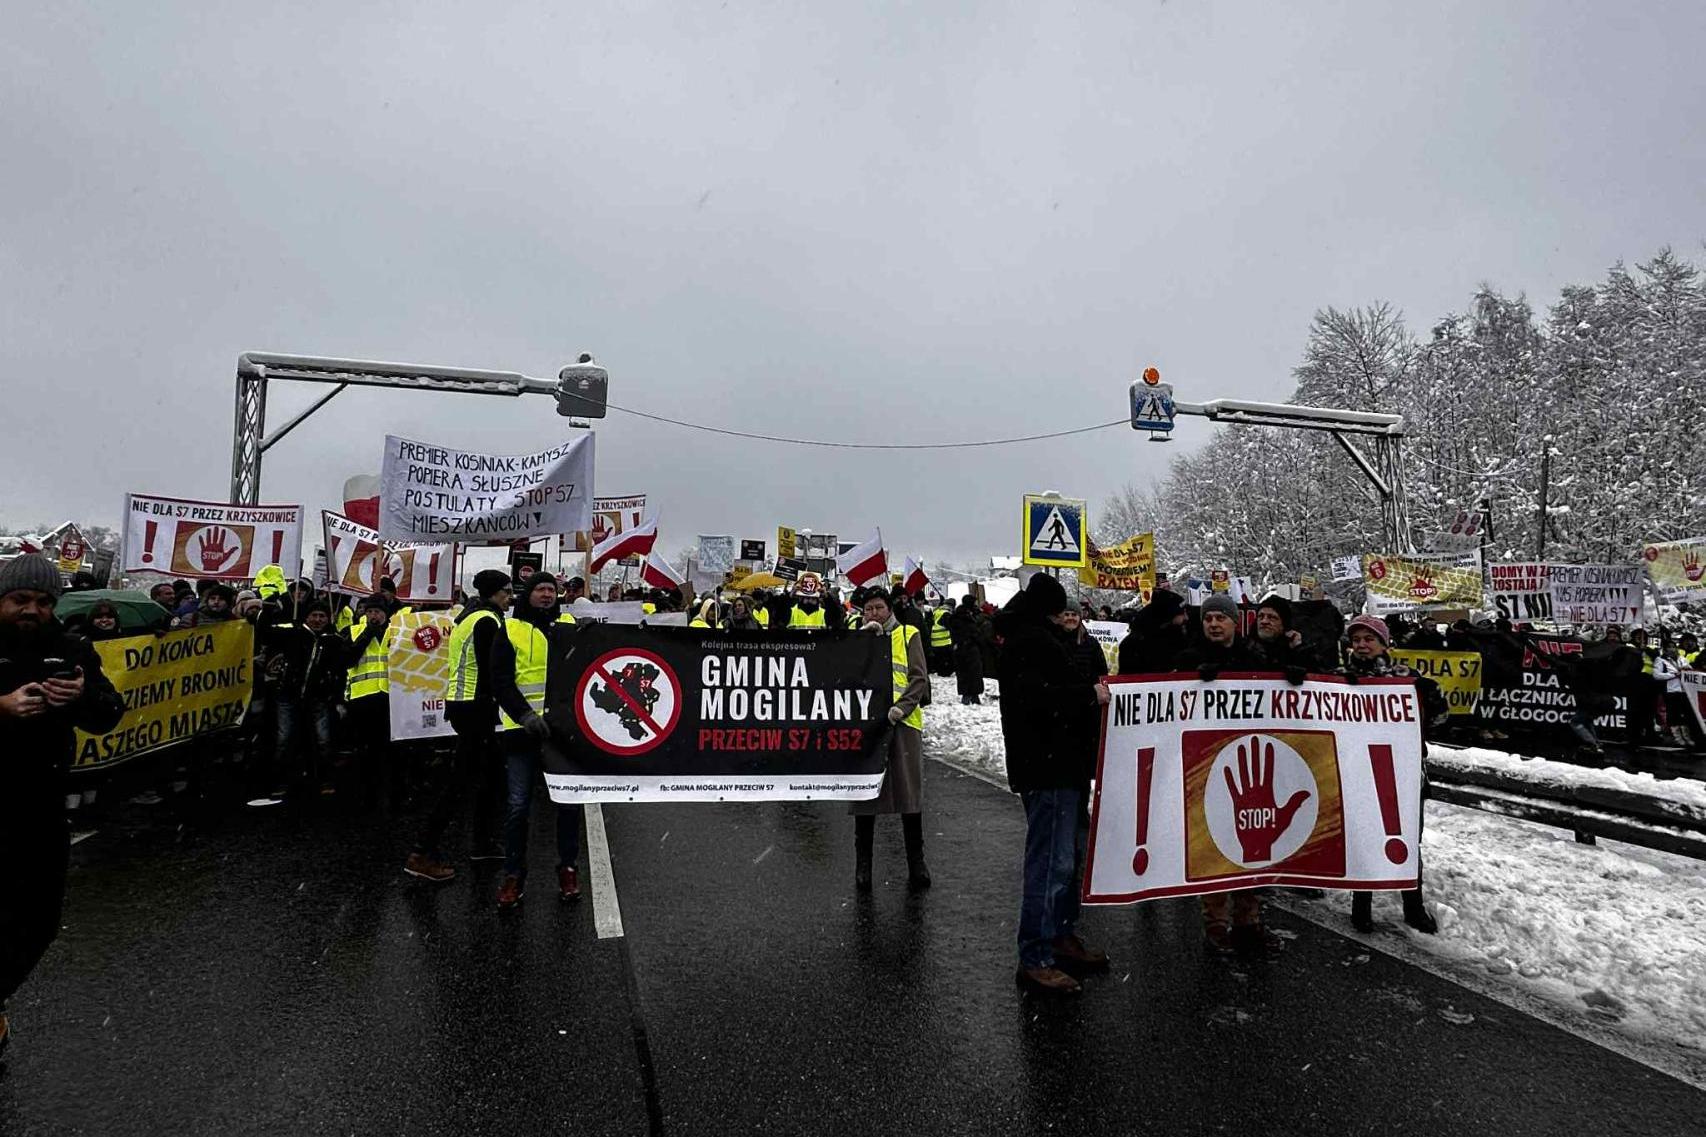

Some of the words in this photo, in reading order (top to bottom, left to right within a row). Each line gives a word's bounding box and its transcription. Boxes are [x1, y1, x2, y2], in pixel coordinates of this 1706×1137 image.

[400, 441, 450, 468] PREMIER
[455, 442, 570, 473] KOSINIAK-KAMYSZ
[408, 464, 464, 490] POPIERA
[470, 468, 544, 492] SŁUSZNE
[405, 489, 498, 512] POSTULATY
[514, 486, 552, 508] STOP
[555, 484, 575, 502] S7
[132, 500, 148, 514] NIE
[152, 503, 172, 516] DLA
[176, 506, 188, 518] S7
[192, 507, 224, 521] PRZEZ
[226, 510, 296, 523] KRZYSZKOWICE
[340, 521, 356, 534] DLA
[358, 528, 370, 538] S7
[202, 551, 224, 560] STOP!
[1492, 565, 1522, 578] DOMY
[1526, 565, 1538, 578] W
[1496, 594, 1520, 620] S7
[1588, 607, 1608, 622] DLA
[418, 628, 432, 638] NIE
[125, 646, 154, 672] DO
[158, 632, 215, 664] KOŃCA
[424, 639, 435, 649] S7
[701, 640, 734, 650] Kolejna
[736, 642, 758, 650] trasa
[760, 642, 816, 651] ekspresowa?
[701, 654, 810, 688] GMINA
[1416, 658, 1452, 677] DLA
[1460, 660, 1480, 677] S7
[124, 678, 176, 712] ZIEMY
[181, 659, 246, 697] BRONIĆ
[1522, 672, 1560, 689] DLA
[1684, 673, 1698, 684] NIE
[422, 700, 444, 712] NIE
[700, 688, 873, 721] MOGILANY
[1114, 693, 1141, 727] NIE
[1146, 692, 1174, 724] DLA
[1180, 690, 1198, 722] S7
[1204, 689, 1264, 720] PRZEZ
[1271, 690, 1416, 723] KRZYSZKOWICE
[1488, 688, 1576, 708] ŁĄCZNIKA
[1481, 706, 1494, 719] W
[78, 720, 163, 766] ASZEGO
[169, 698, 245, 738] MIASTA
[699, 729, 782, 751] PRZECIW
[788, 728, 811, 750] S7
[816, 730, 823, 750] i
[827, 729, 863, 750] S52
[1238, 808, 1276, 830] STOP!
